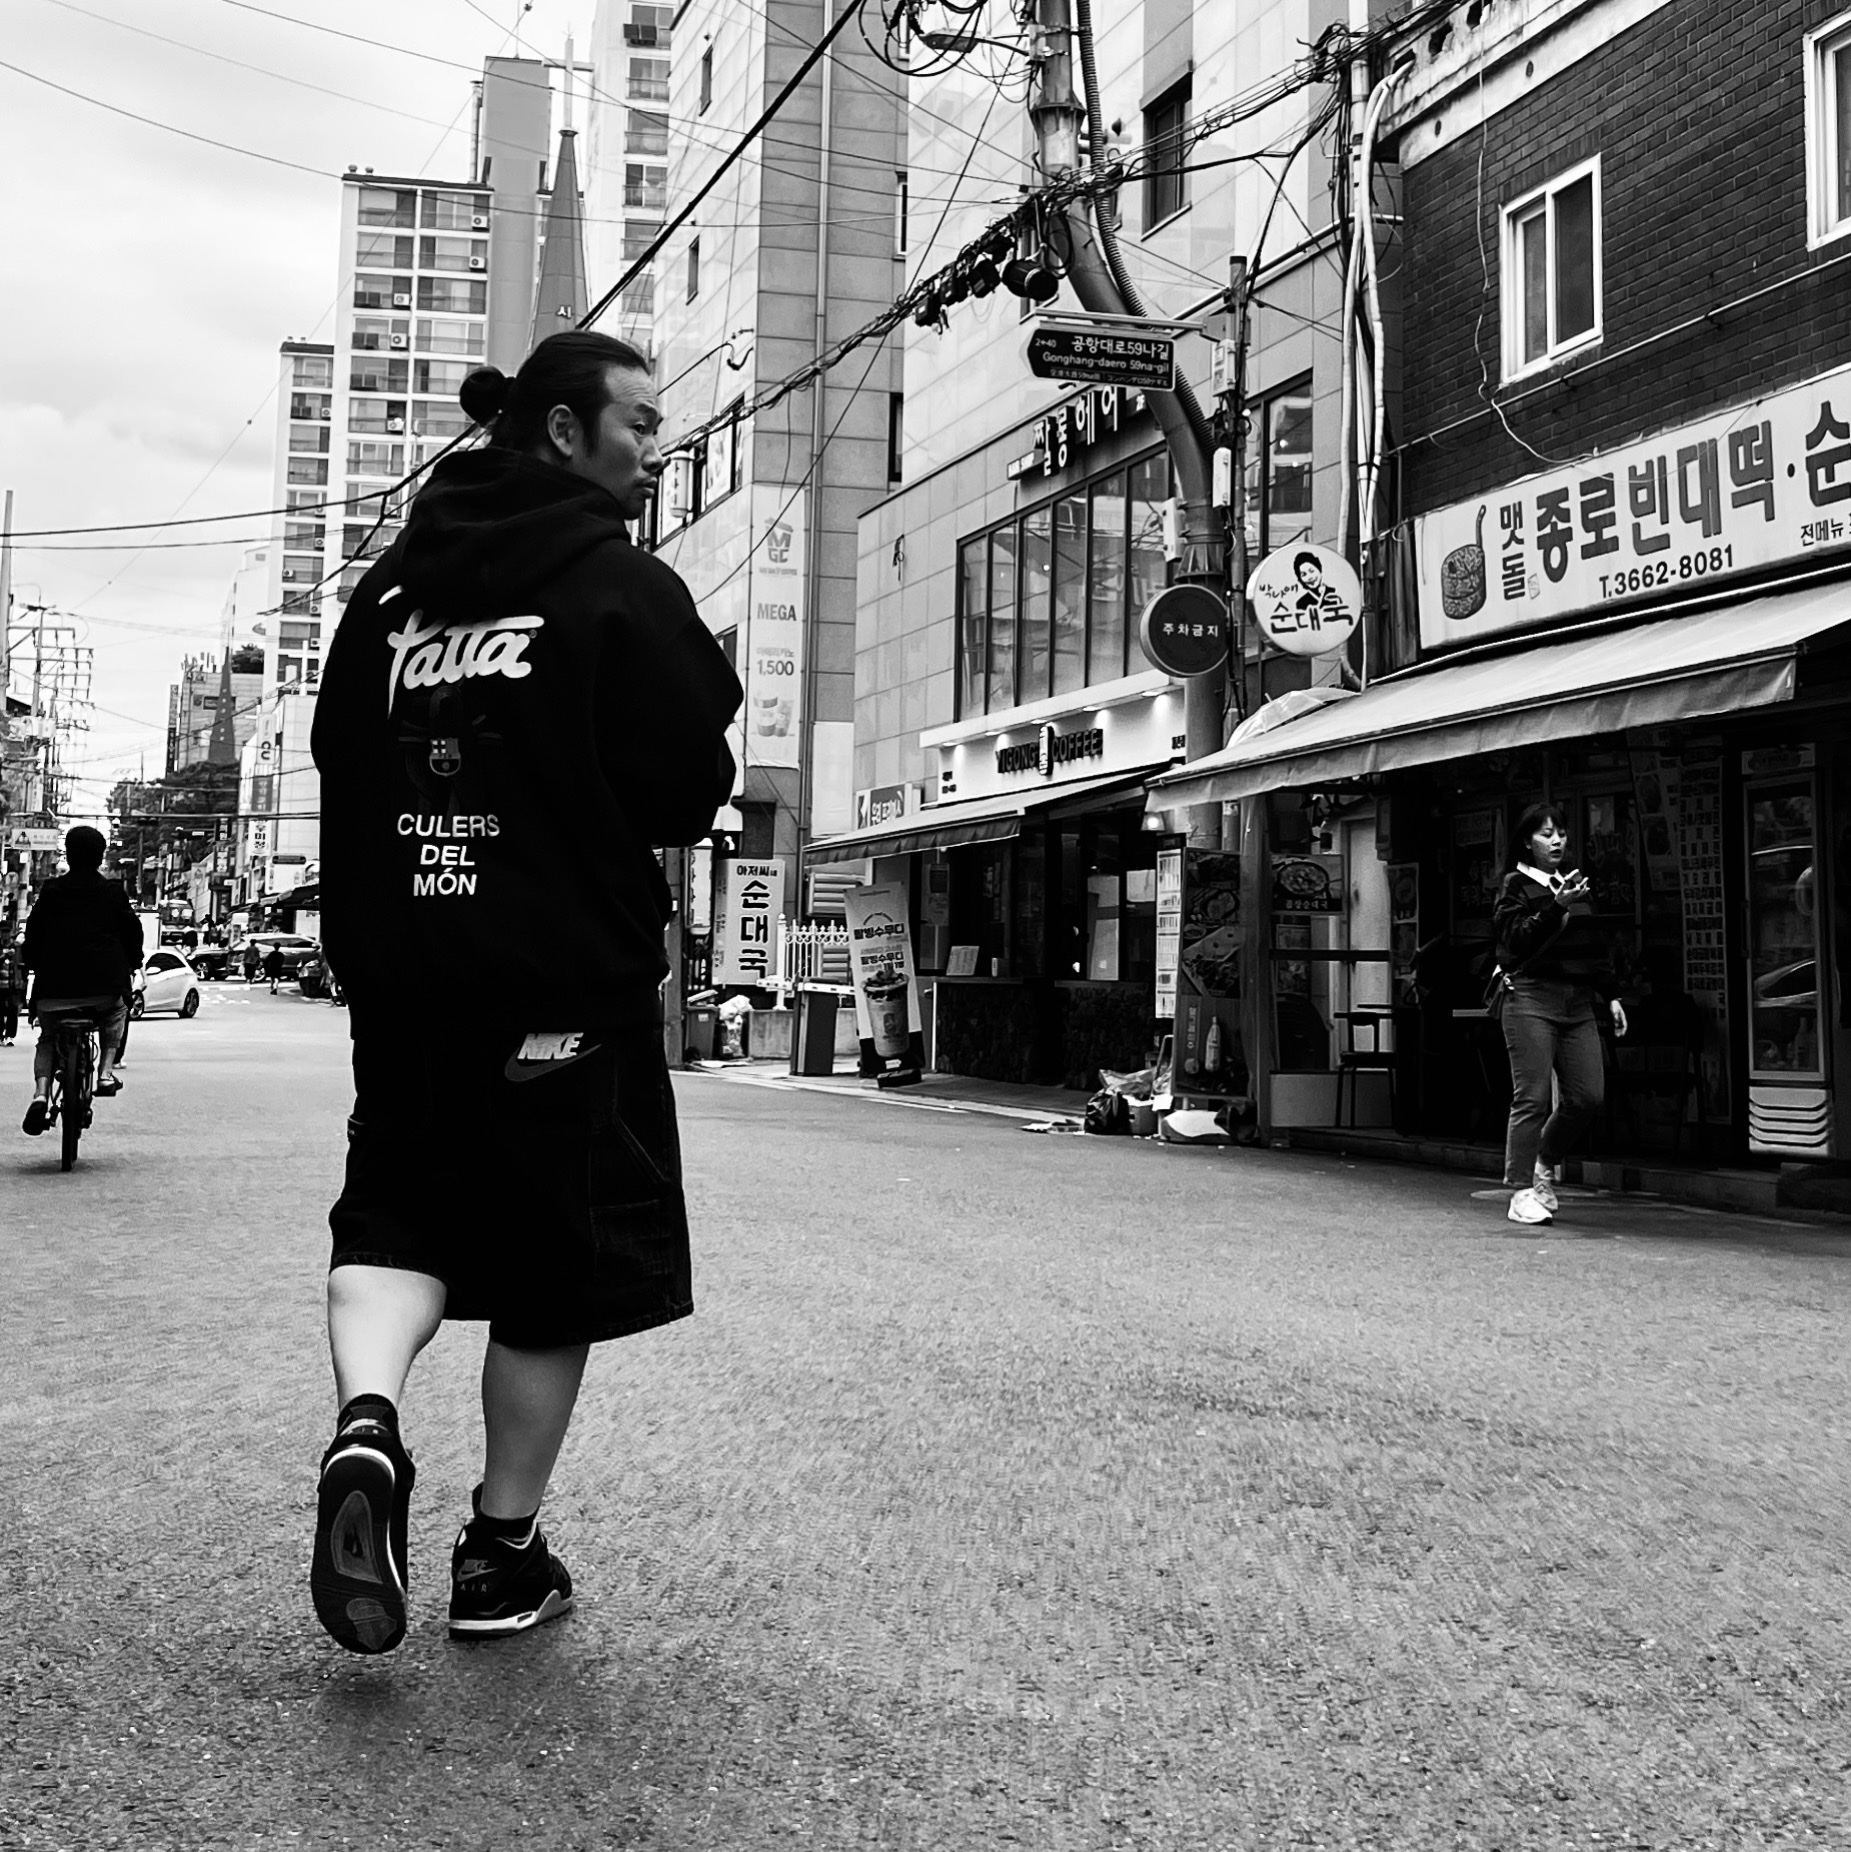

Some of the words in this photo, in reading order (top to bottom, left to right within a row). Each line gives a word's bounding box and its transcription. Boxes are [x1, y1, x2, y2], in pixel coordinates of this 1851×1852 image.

[1042, 351, 1127, 369] Gonghang-daero
[1129, 359, 1169, 374] 59na-gil
[1071, 335, 1169, 361] 공항대로59나길
[1536, 420, 1775, 583] 종로빈대떡
[1800, 517, 1844, 547] 전메뉴
[1500, 500, 1526, 602] 맷돌
[1599, 543, 1733, 599] T.3662-8081
[756, 603, 797, 622] MEGA
[1270, 602, 1354, 634] 순대국
[1162, 622, 1219, 638] 주차금지
[756, 660, 795, 676] 1,500
[1051, 728, 1100, 763] COFFEE
[397, 814, 500, 837] CULERS
[420, 844, 475, 866] DEL
[412, 867, 477, 896] MÓN
[738, 879, 771, 979] 순대국
[516, 1031, 585, 1060] NIKE
[460, 1583, 488, 1593] AIR
